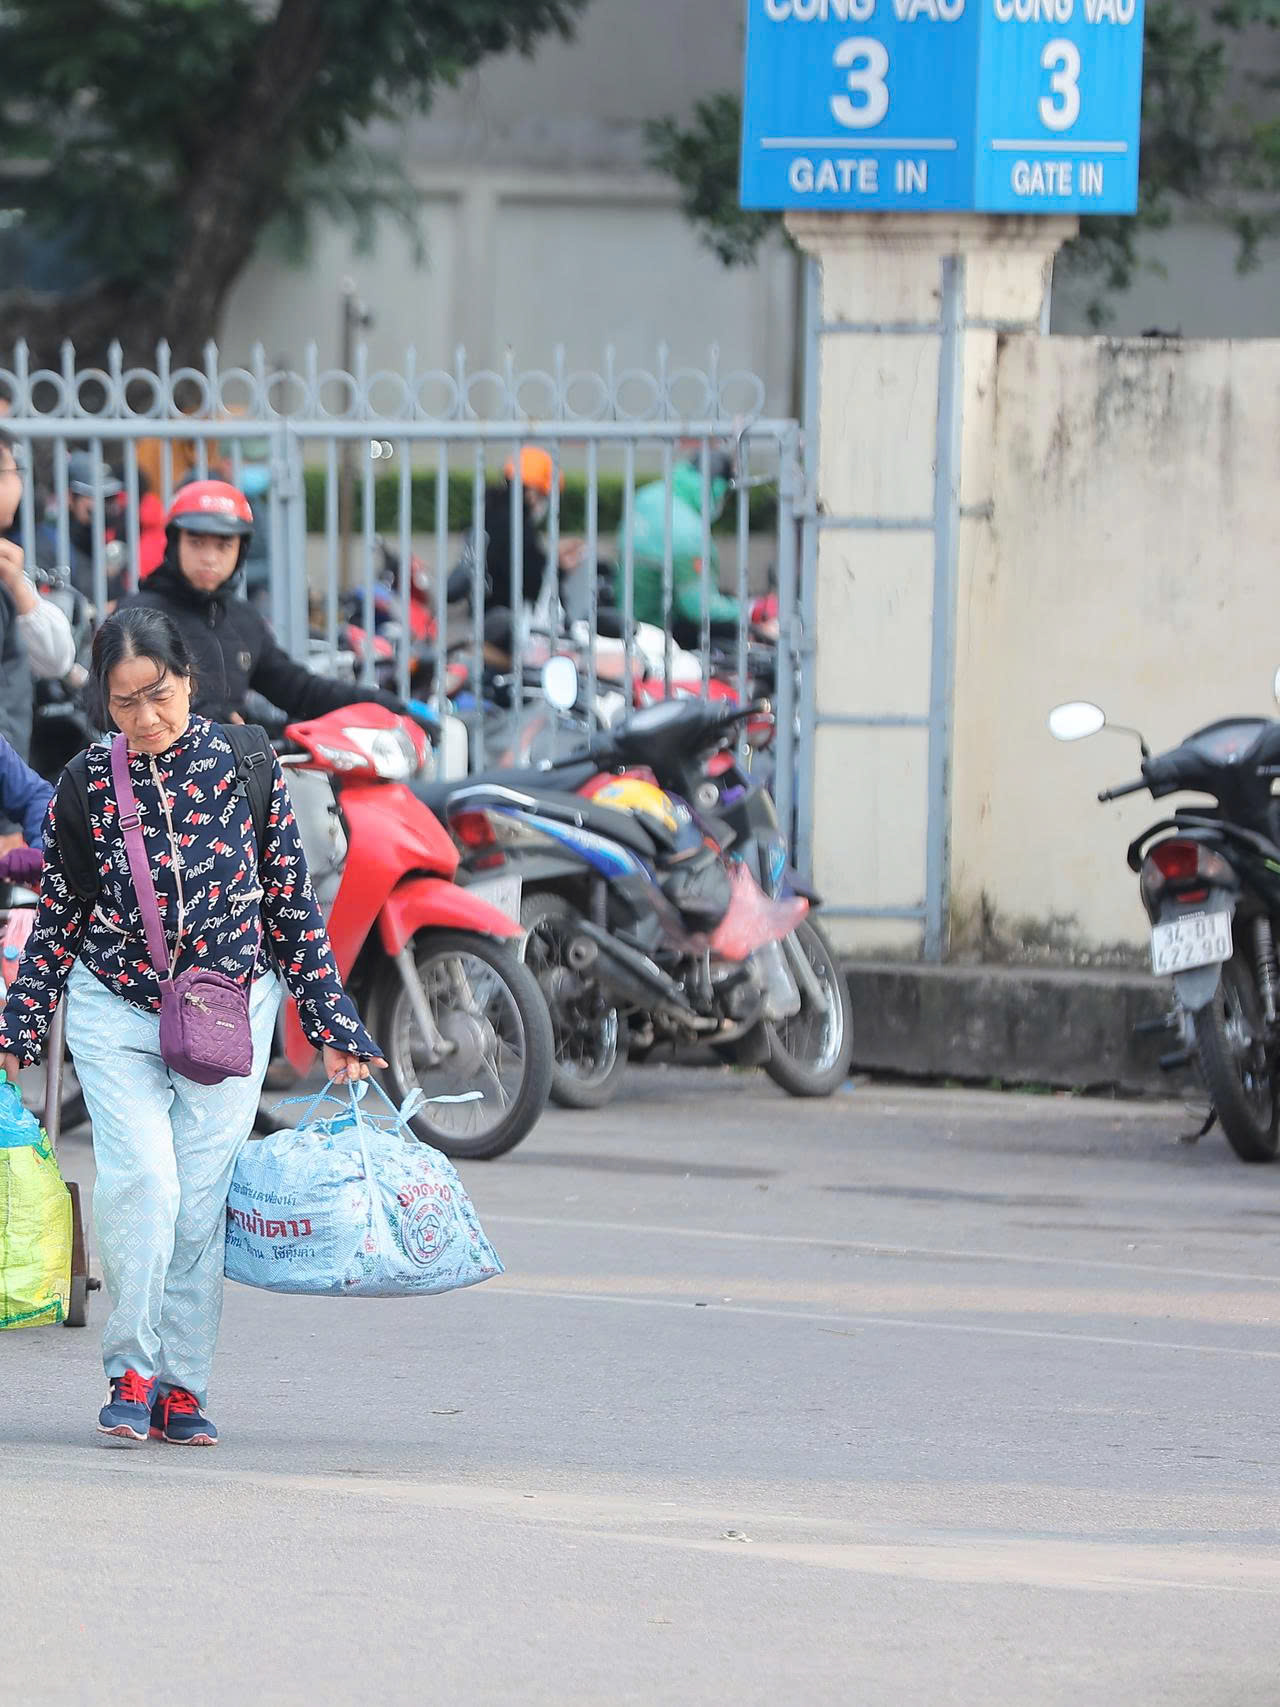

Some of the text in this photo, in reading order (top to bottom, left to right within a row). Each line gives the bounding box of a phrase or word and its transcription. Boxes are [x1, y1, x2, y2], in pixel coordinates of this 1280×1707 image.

[829, 36, 890, 130] 3
[1038, 37, 1081, 132] 3
[788, 158, 928, 194] GATE IN
[1010, 160, 1104, 197] GATE IN
